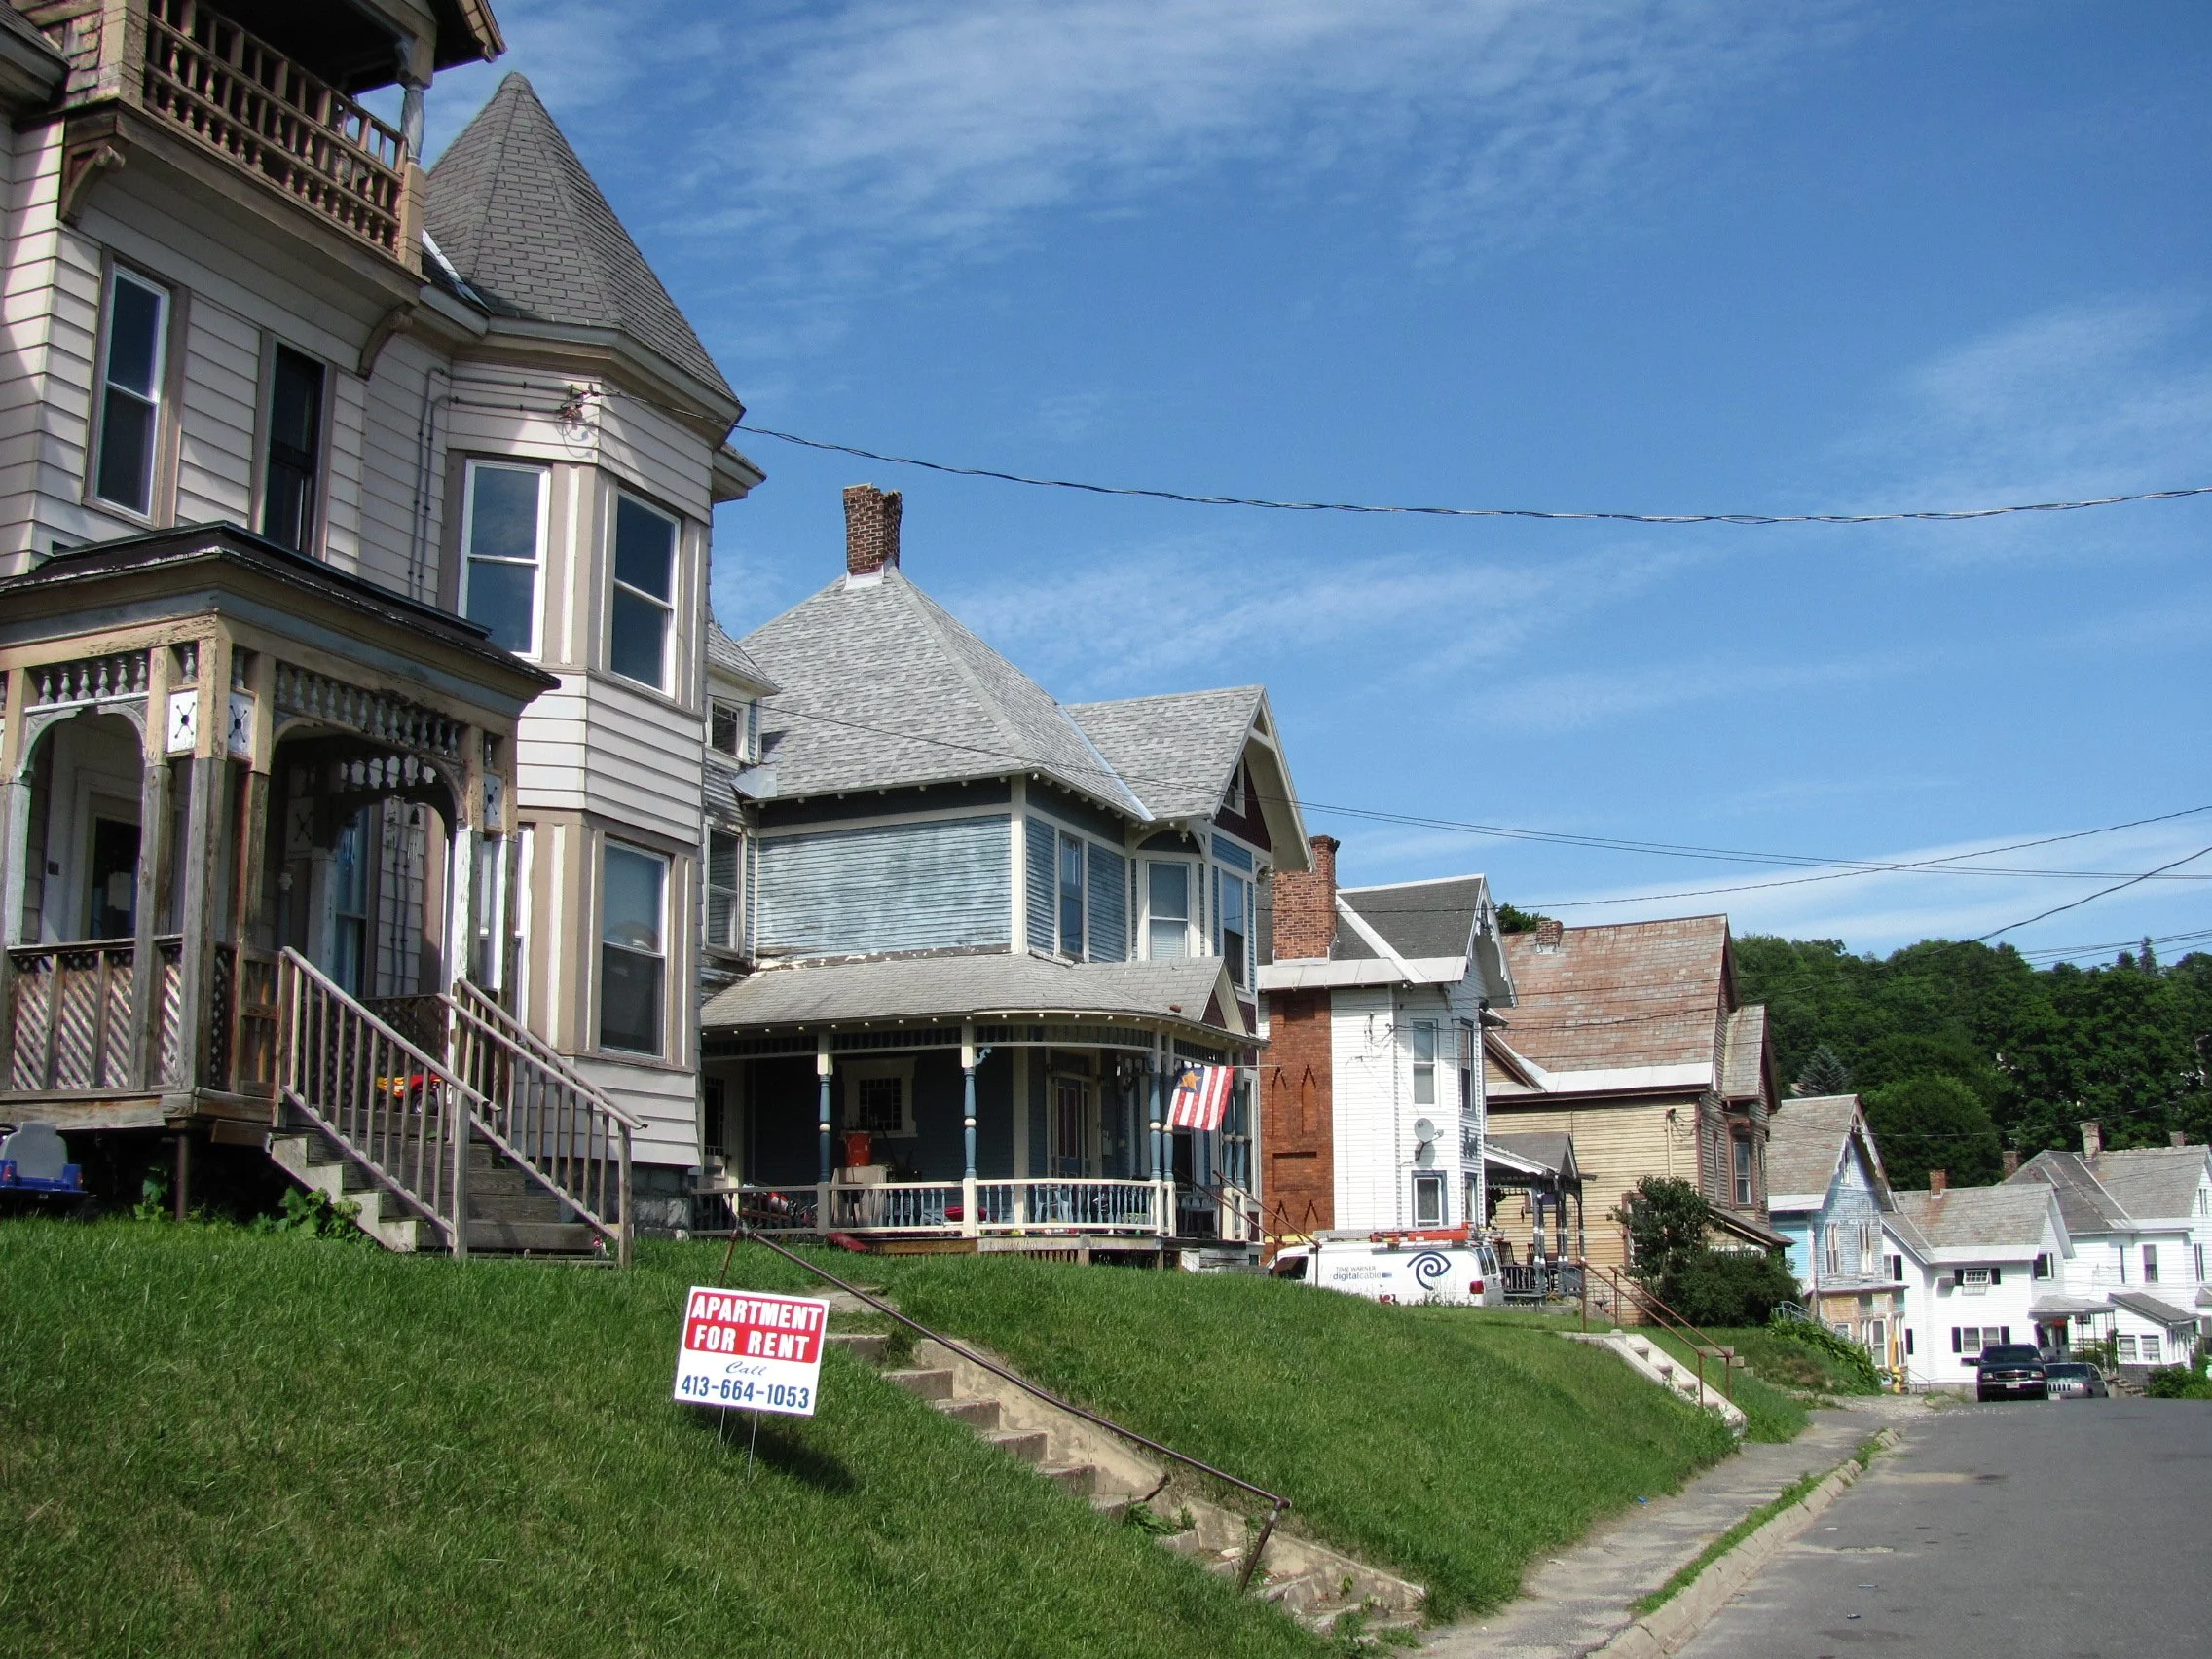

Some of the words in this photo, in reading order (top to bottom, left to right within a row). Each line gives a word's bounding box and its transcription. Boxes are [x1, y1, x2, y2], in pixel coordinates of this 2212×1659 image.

[1333, 1272, 1381, 1281] digitalcable
[691, 1295, 823, 1331] APARTMENT
[693, 1324, 736, 1352] FOR
[747, 1330, 810, 1360] RENT
[725, 1360, 767, 1376] Call
[682, 1374, 810, 1409] 413-664-1053
